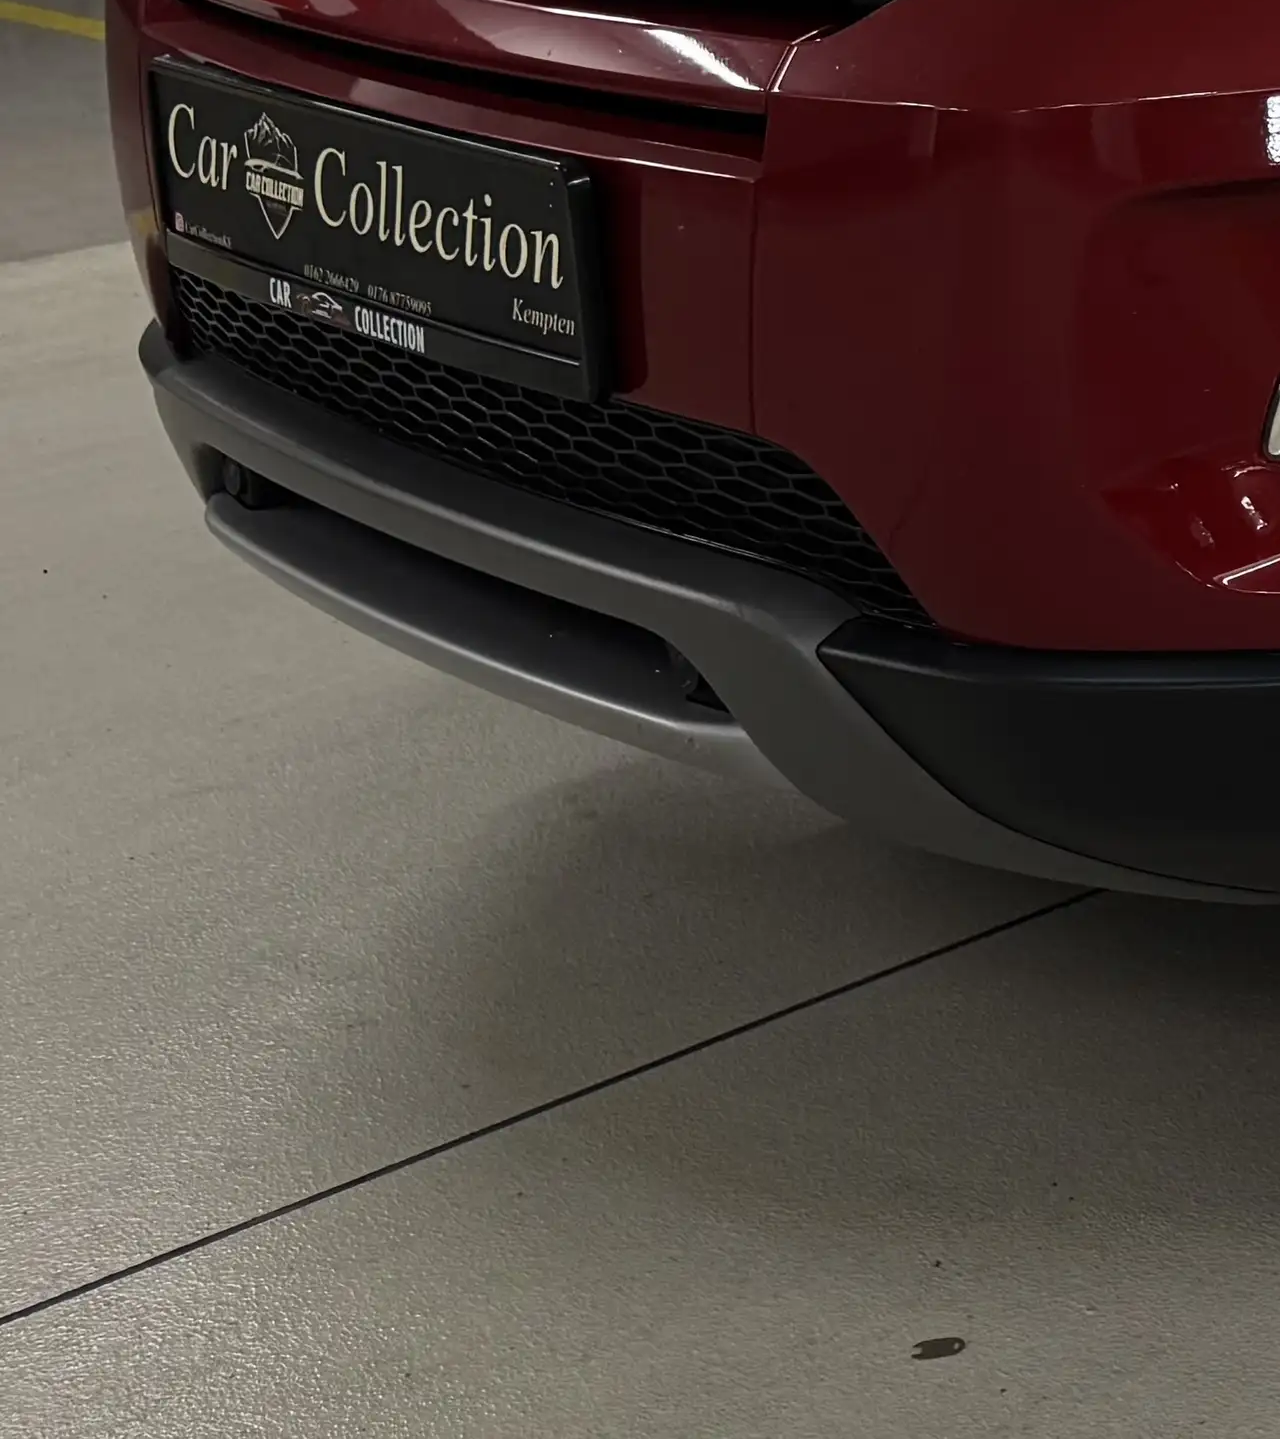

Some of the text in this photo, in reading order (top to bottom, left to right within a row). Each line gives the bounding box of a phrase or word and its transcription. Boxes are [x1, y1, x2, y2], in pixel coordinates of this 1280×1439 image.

[168, 103, 564, 289] Car Collection
[246, 171, 261, 193] CAR
[269, 277, 425, 354] CAR COLLECTION
[512, 297, 575, 336] Kempten
